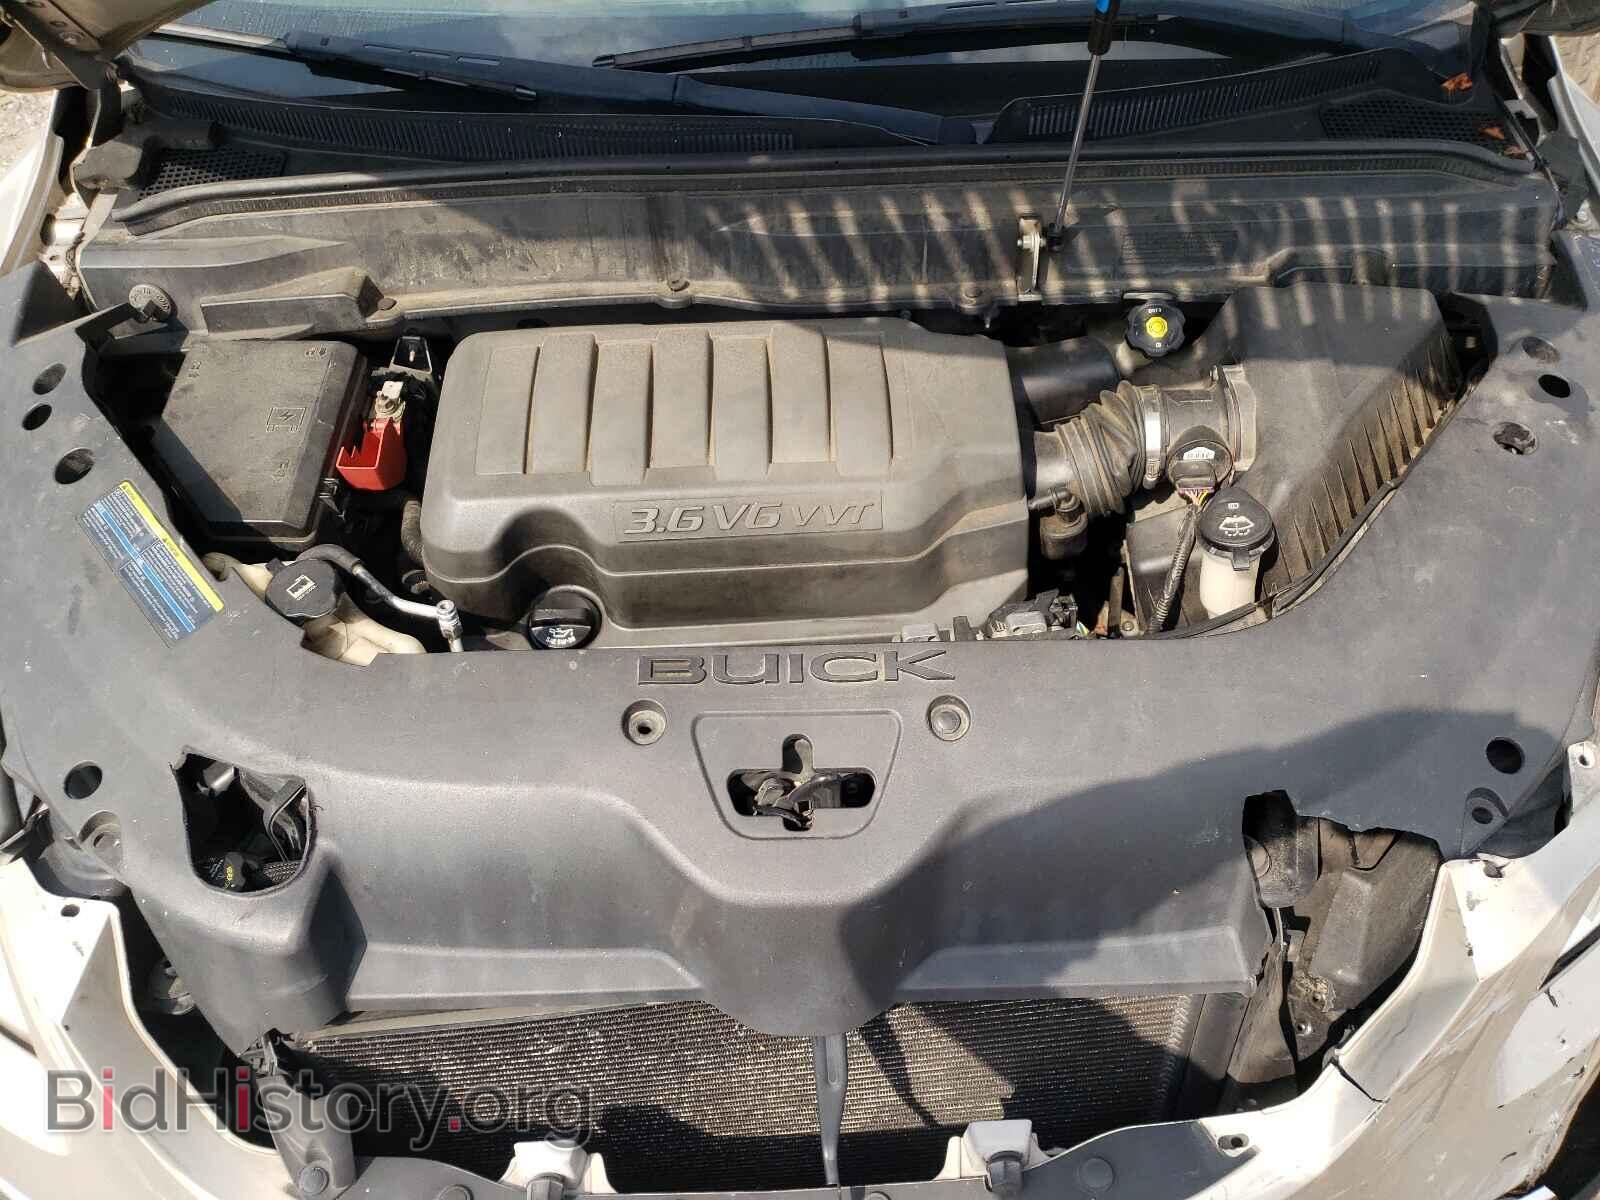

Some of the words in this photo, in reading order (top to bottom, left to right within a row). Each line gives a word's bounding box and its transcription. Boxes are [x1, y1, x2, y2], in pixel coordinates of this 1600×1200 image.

[623, 505, 704, 534] 3.6
[712, 502, 782, 531] V6
[792, 502, 875, 527] VVT
[638, 650, 955, 685] BUICK
